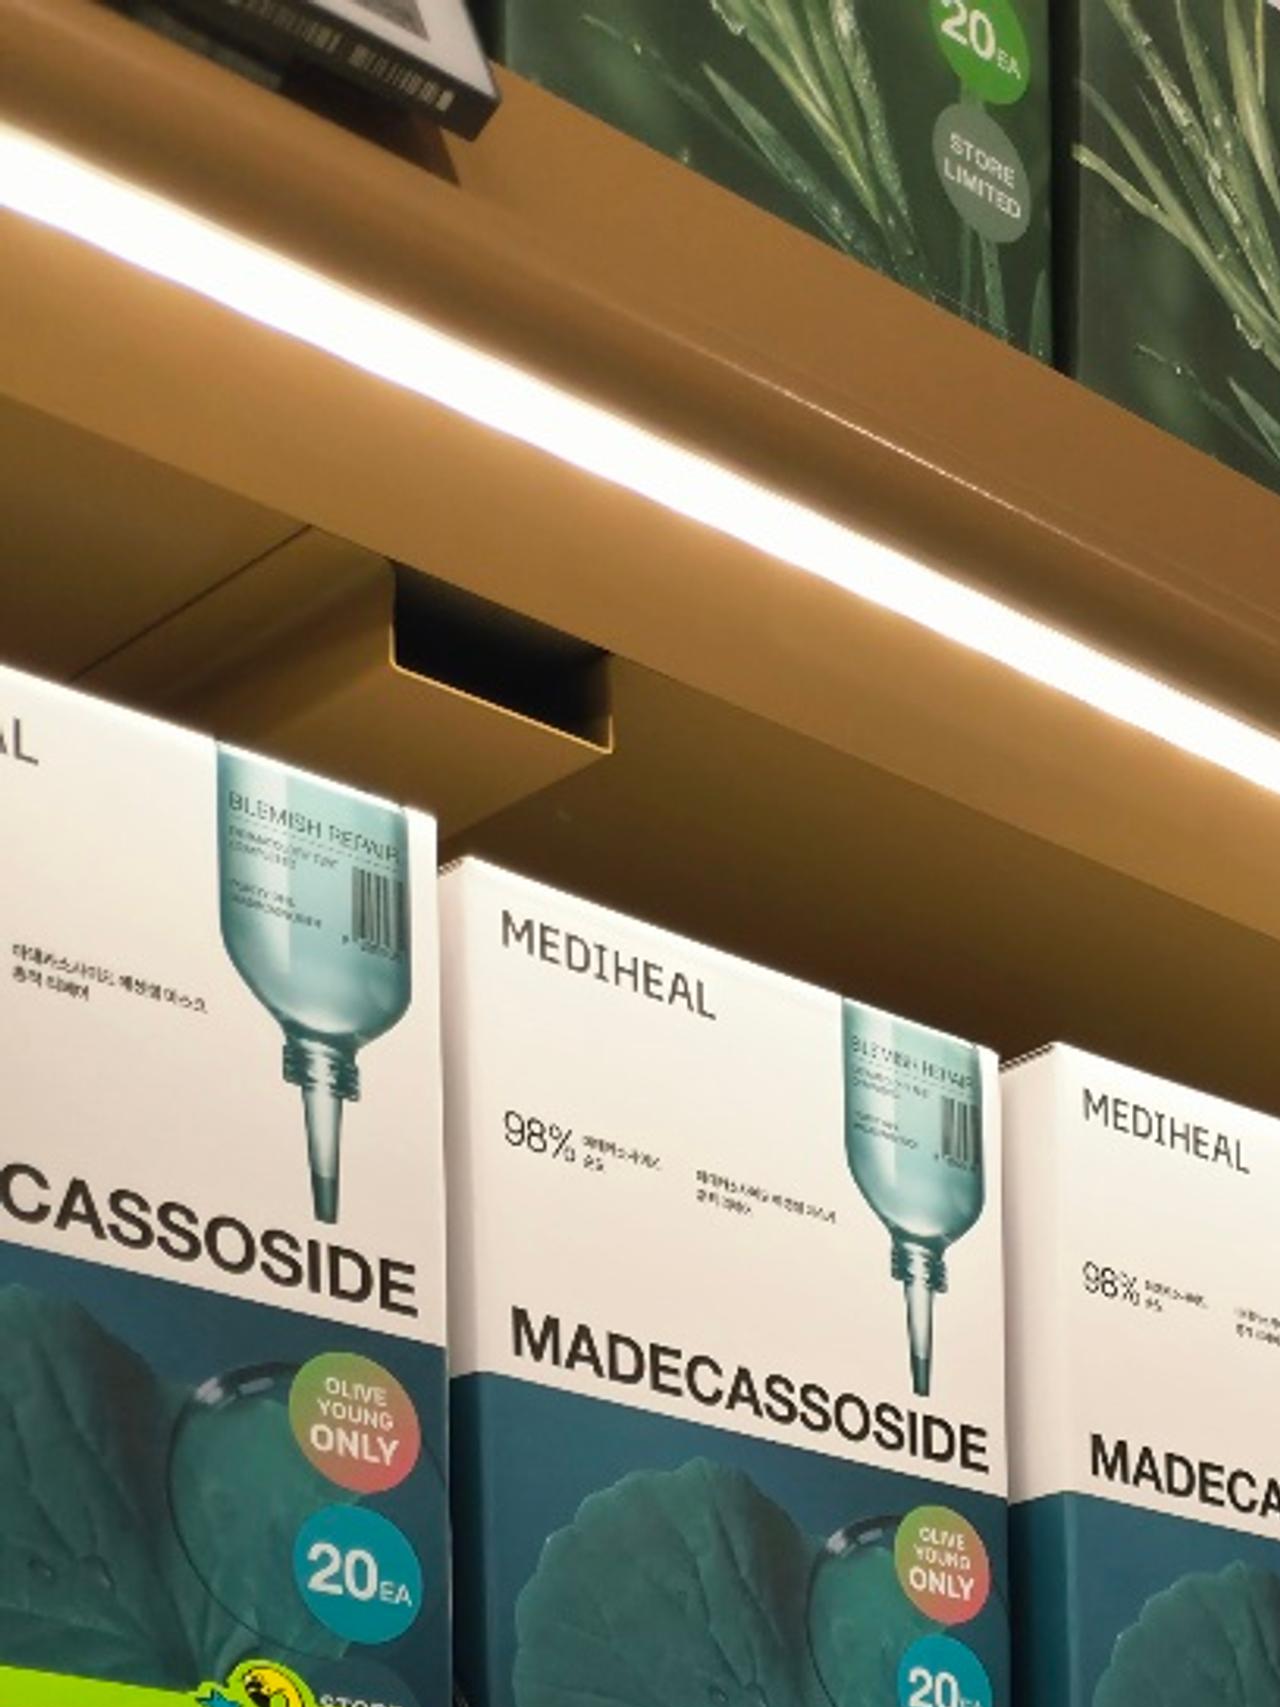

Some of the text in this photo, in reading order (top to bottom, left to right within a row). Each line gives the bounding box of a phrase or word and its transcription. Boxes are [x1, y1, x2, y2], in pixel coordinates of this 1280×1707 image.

[948, 131, 1017, 190] STORE
[942, 156, 1023, 224] LIMITED
[500, 908, 717, 1021] MEDIHEAL
[502, 1109, 577, 1165] 98%
[1081, 1088, 1250, 1176] MEDIHEAL
[0, 1161, 420, 1317] CASSOSIDE
[1081, 1260, 1141, 1309] 98%
[316, 1398, 395, 1432] YOUNG
[323, 1375, 389, 1409] OLIVE
[510, 1304, 991, 1475] MADECASSOSIDE
[308, 1423, 400, 1468] ONLY
[919, 1524, 968, 1553] OLIVE
[908, 1565, 975, 1603] ONLY
